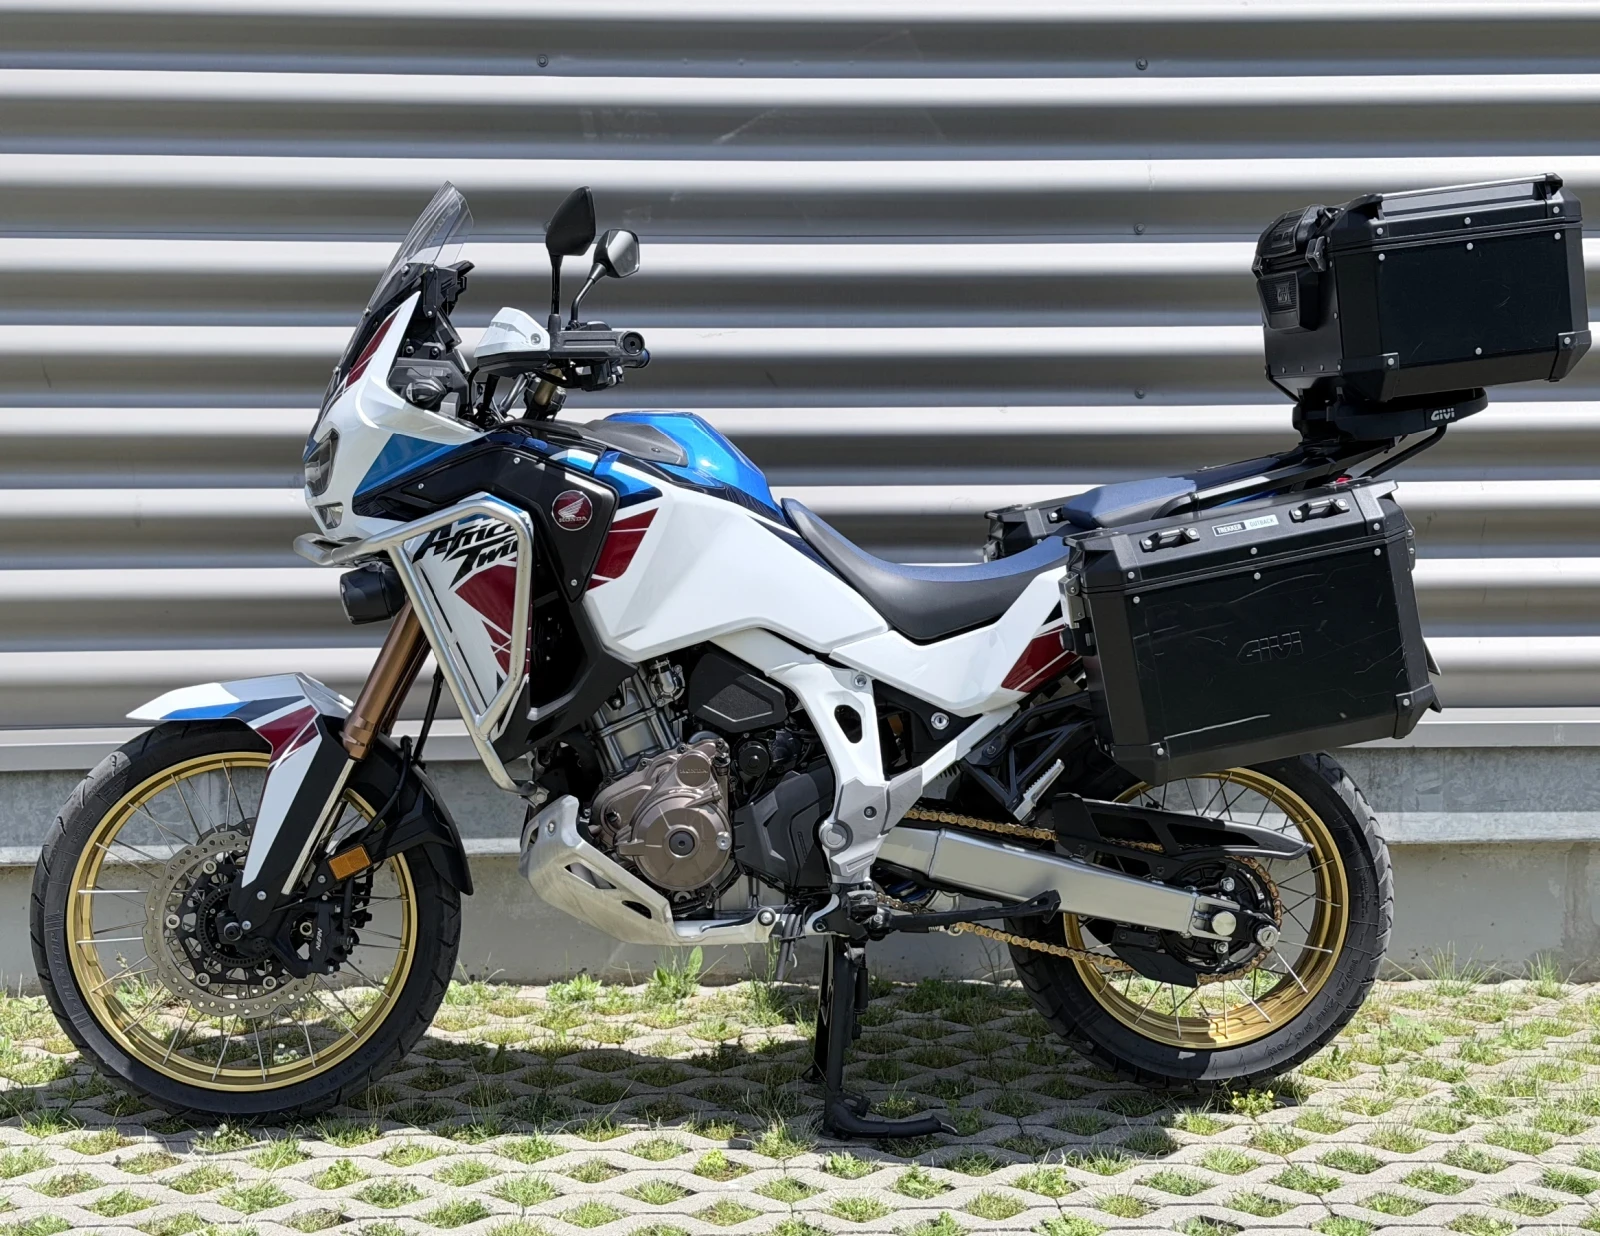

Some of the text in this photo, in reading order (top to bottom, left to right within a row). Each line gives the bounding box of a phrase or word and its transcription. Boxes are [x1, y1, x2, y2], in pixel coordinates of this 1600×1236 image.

[1431, 408, 1455, 421] GIVI
[1216, 518, 1275, 534] TREKKER OUTBACK
[1236, 631, 1304, 666] GIVI
